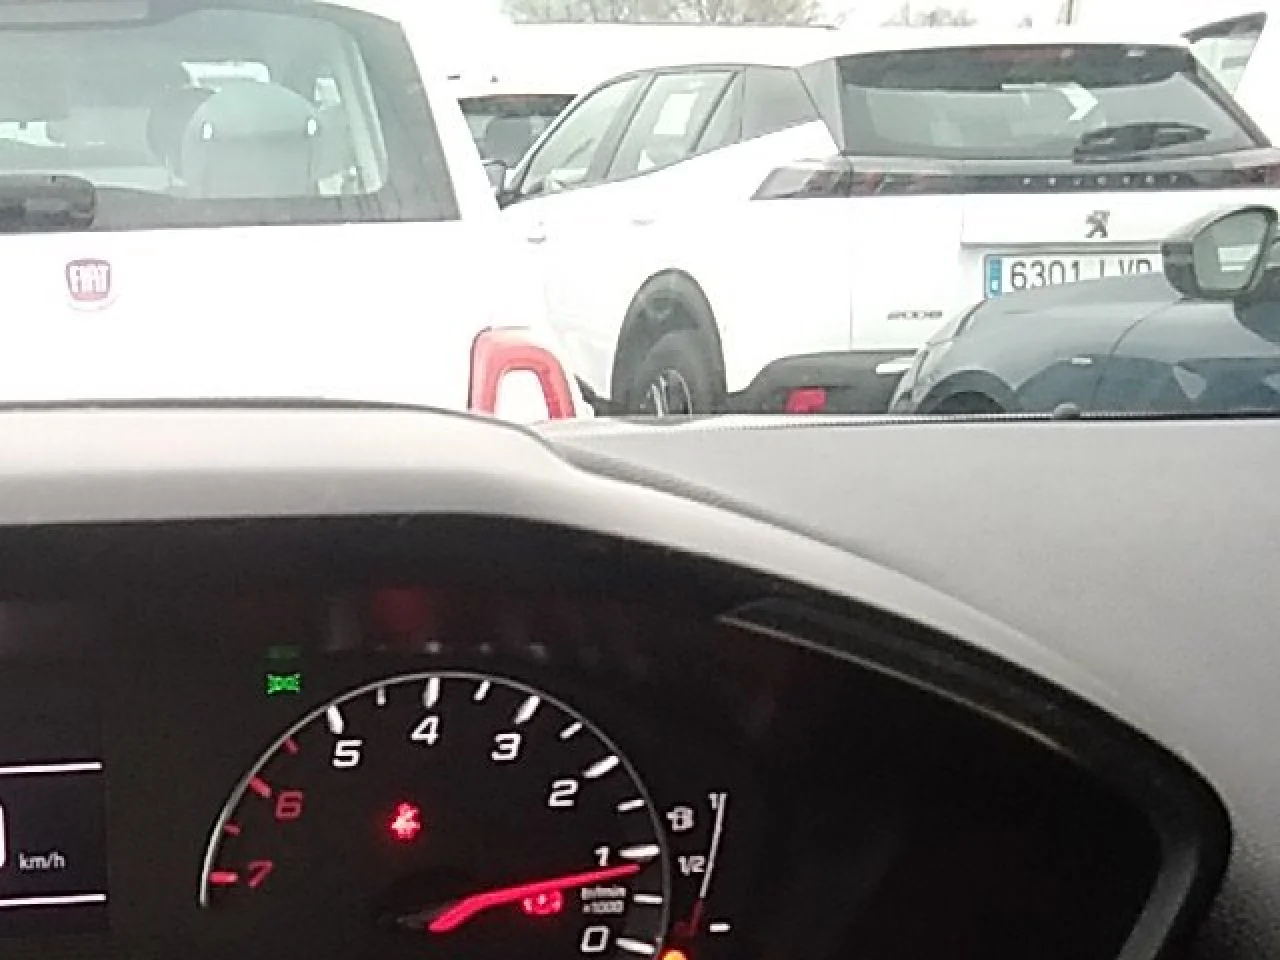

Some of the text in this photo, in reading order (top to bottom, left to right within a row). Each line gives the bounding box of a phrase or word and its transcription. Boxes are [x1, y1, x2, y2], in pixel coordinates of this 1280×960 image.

[69, 264, 109, 293] FIAT
[1010, 259, 1080, 291] 6301
[411, 715, 440, 745] 4
[333, 739, 362, 767] 5
[491, 733, 521, 761] 3
[275, 791, 303, 820] 6
[549, 780, 579, 807] 2
[19, 851, 66, 870] km/h
[595, 845, 610, 868] 1
[677, 855, 706, 876] 1/2
[247, 860, 274, 889] 7
[580, 925, 610, 953] 0
